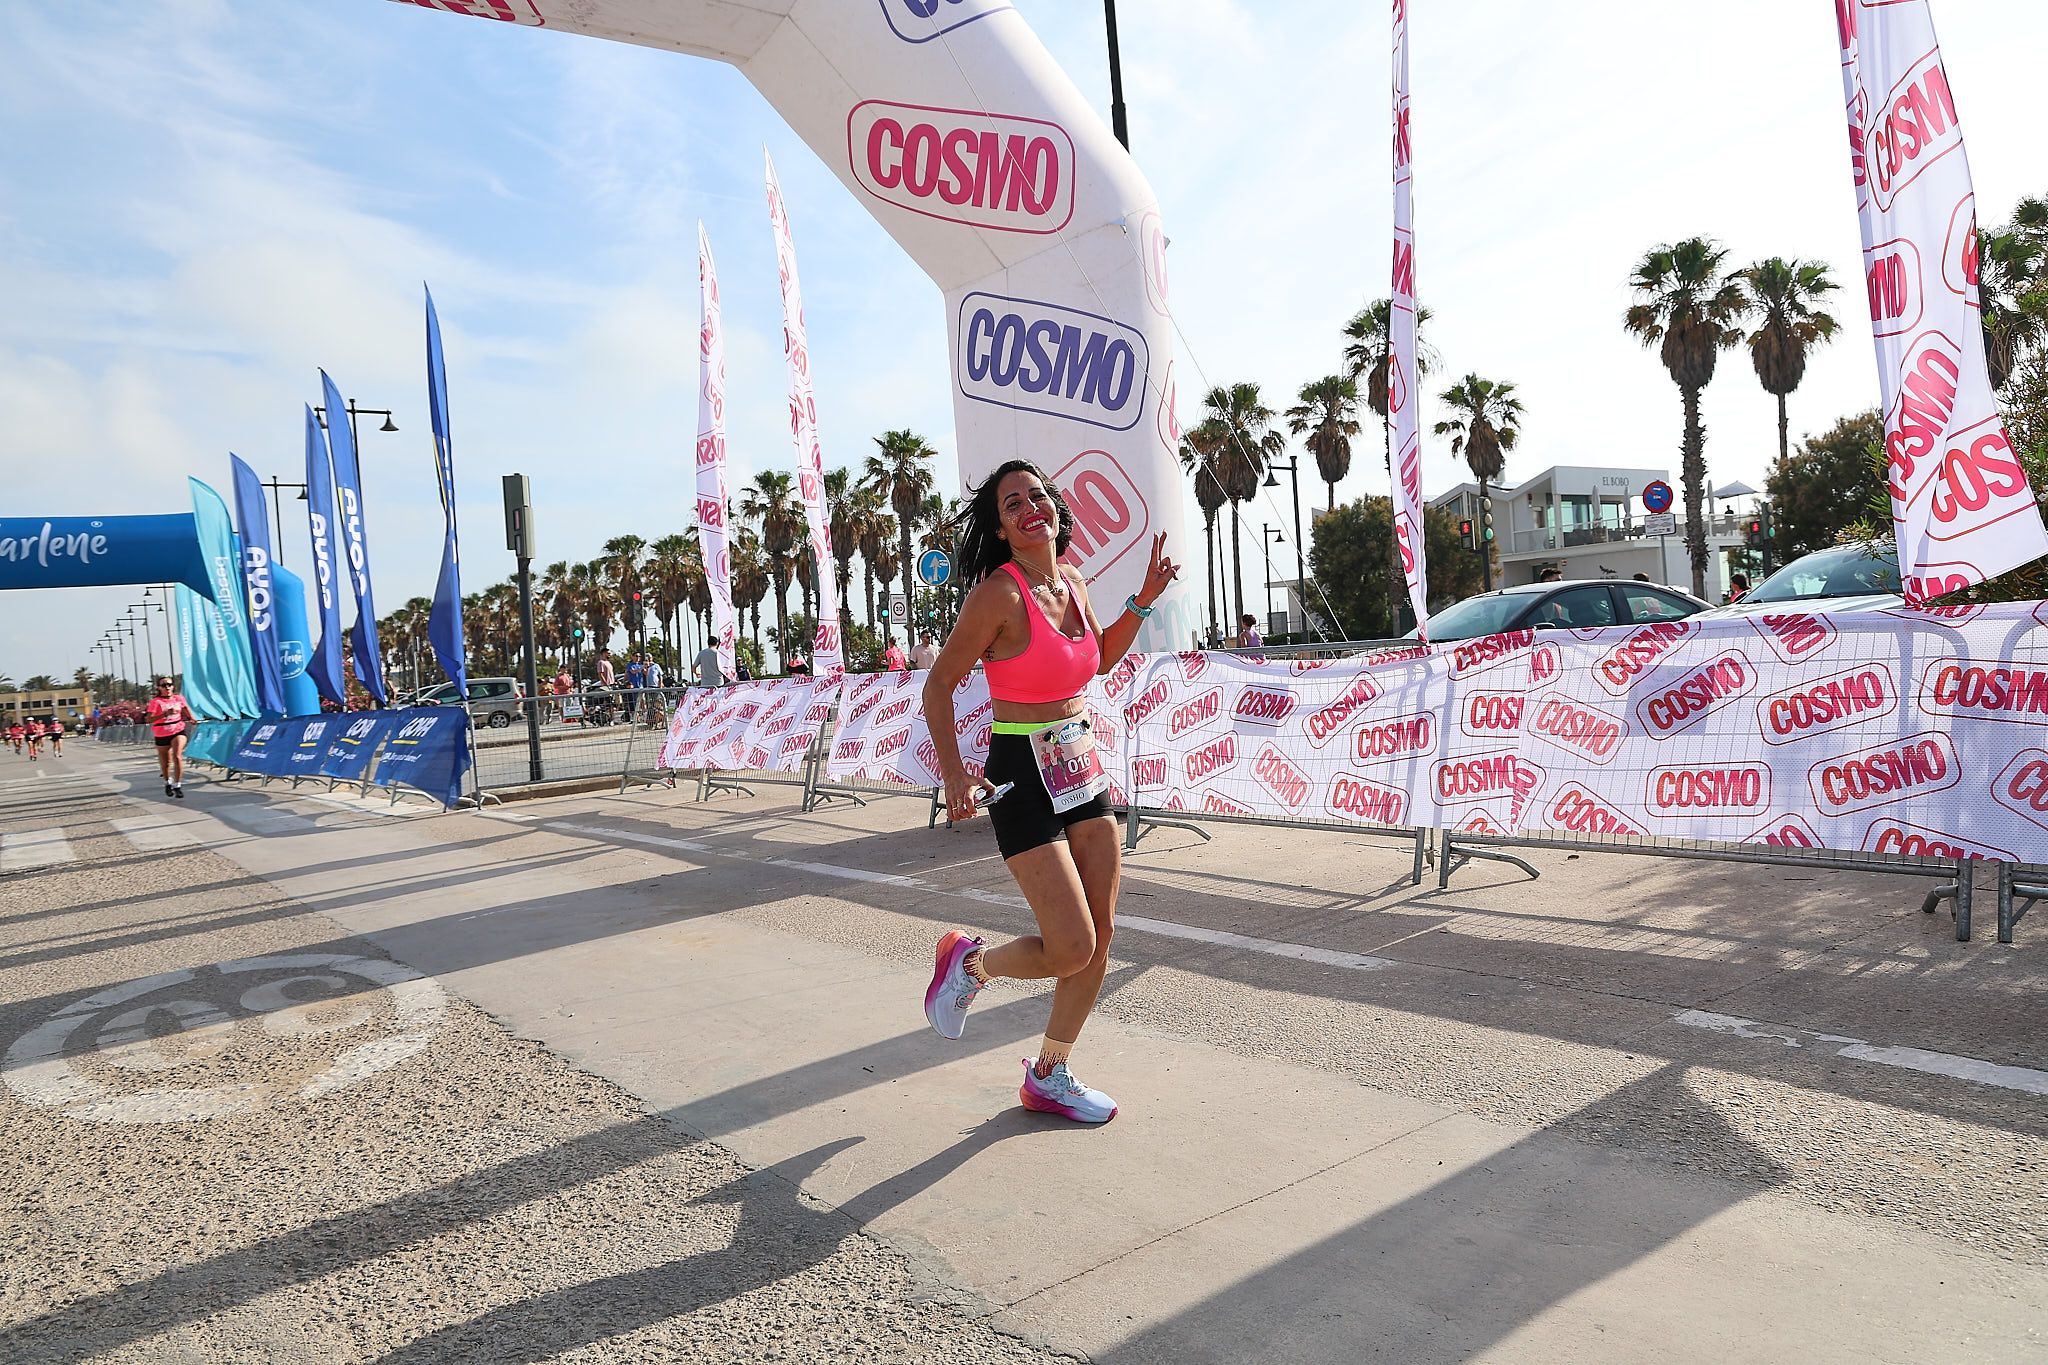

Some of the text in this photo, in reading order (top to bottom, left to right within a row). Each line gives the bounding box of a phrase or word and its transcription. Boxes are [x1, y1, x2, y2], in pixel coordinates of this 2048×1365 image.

[1875, 64, 1958, 192] COSM
[867, 117, 1059, 216] COSMO
[967, 308, 1135, 411] COSMO
[1602, 476, 1630, 487] EL BOBO
[0, 521, 108, 568] arlene
[1453, 628, 1534, 672] COSMO
[850, 688, 884, 722] COSMO
[875, 698, 911, 726] COSMO
[1123, 680, 1168, 731] COSMO
[1236, 690, 1294, 720] COSMO
[1309, 679, 1377, 739] COSMO
[1647, 657, 1746, 730] COSMO
[1769, 670, 1885, 735] COSMO
[1933, 664, 2048, 716] COSM
[1171, 691, 1219, 735] COSMO
[1535, 699, 1620, 756] COSMO
[781, 732, 813, 754] COSMO
[835, 740, 864, 760] COSMO
[875, 728, 909, 758] COSMO
[1186, 736, 1235, 781] COSMO
[1358, 717, 1430, 759] COSMO
[1131, 757, 1167, 786] COSMO
[1255, 748, 1308, 807] COSMO
[1437, 754, 1517, 798] COSMO
[1656, 768, 1761, 808] COSMO
[1821, 738, 1948, 806] COSMO
[1061, 792, 1085, 806] OYSHO
[1333, 778, 1402, 825] COSMO
